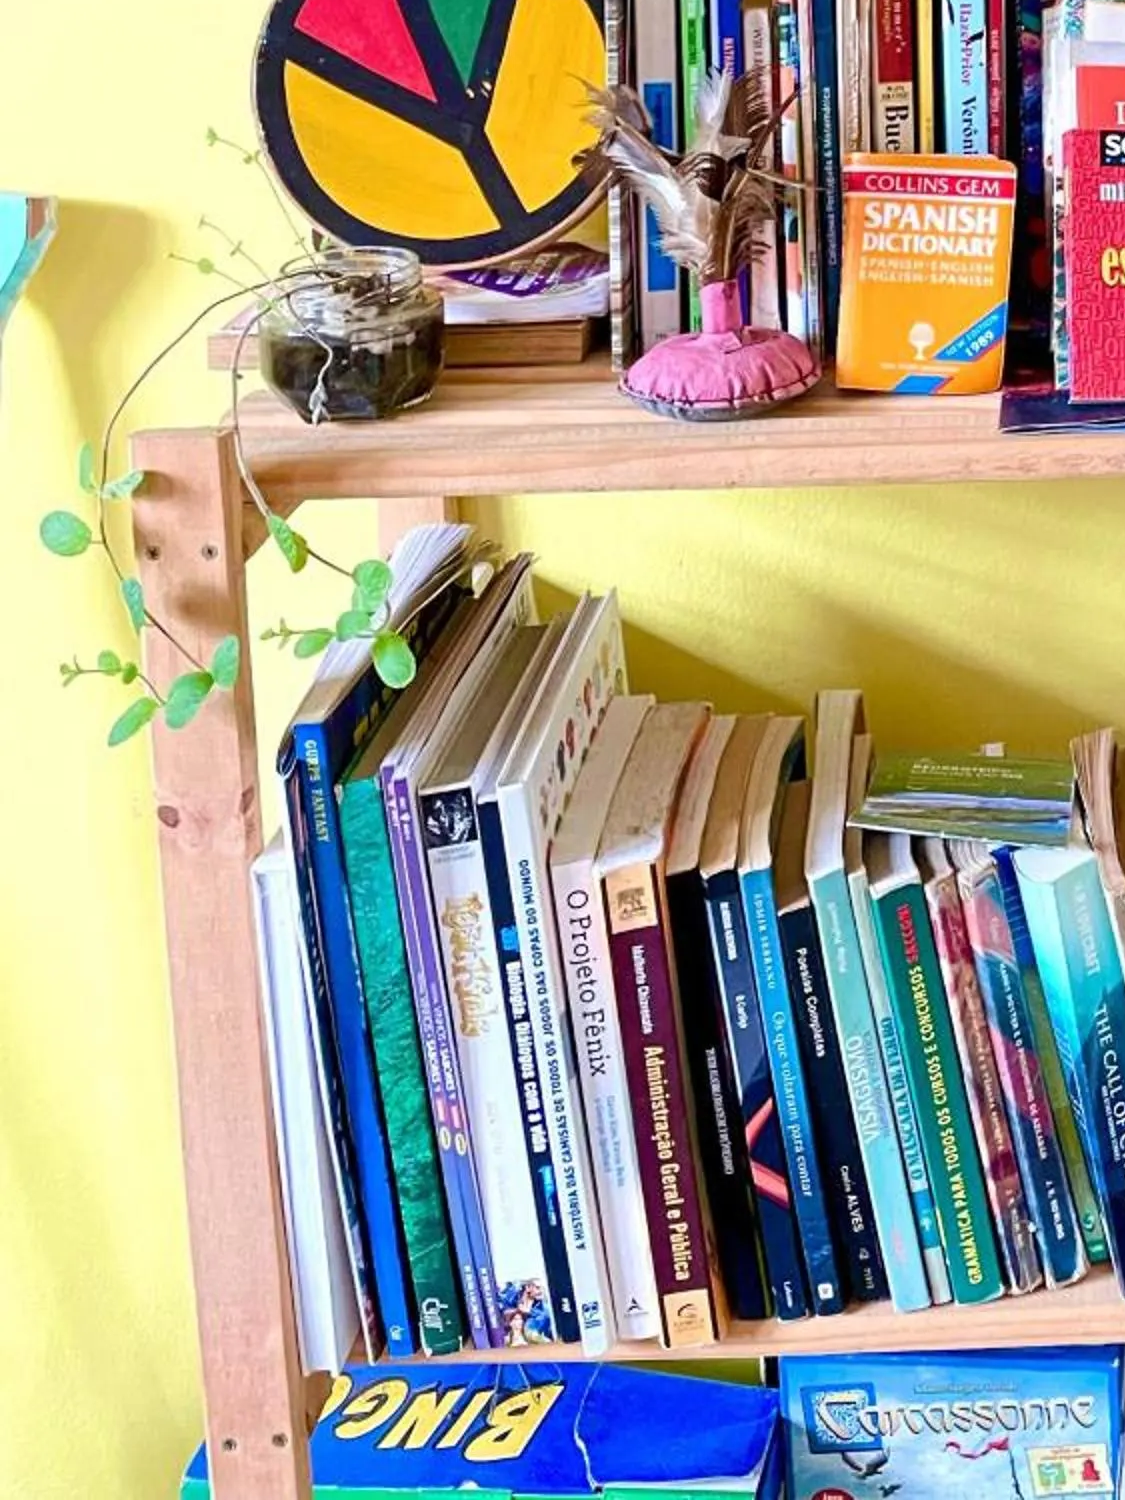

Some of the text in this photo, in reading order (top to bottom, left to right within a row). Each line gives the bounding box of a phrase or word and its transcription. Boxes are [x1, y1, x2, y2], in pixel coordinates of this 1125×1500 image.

[960, 46, 974, 85] Prior
[865, 174, 1000, 197] COLLINS GEM
[864, 201, 999, 235] SPANISH
[862, 231, 997, 257] DICTIONARY
[965, 330, 994, 357] 1989
[310, 787, 331, 843] FANTASY
[519, 857, 536, 903] MUNDO
[526, 906, 539, 924] DO
[529, 927, 545, 967] COPAS
[535, 969, 549, 994] DAS
[564, 888, 611, 1077] O Projeto Fênix
[539, 996, 555, 1036] JOGOS
[794, 946, 827, 1058] Poesias Completas
[913, 964, 936, 1042] CONCURSOS
[771, 1032, 788, 1059] que
[1092, 1005, 1114, 1046] THE
[545, 1039, 558, 1056] OS
[924, 1043, 938, 1053] E
[548, 1058, 564, 1093] TODOS
[779, 1060, 802, 1121] voltaram
[844, 1034, 881, 1144] VISAGISMO
[890, 1068, 906, 1091] DE
[929, 1055, 948, 1105] CURSOS
[1100, 1048, 1125, 1097] CALL
[936, 1107, 952, 1125] OS
[556, 1114, 573, 1163] CAMISAS
[788, 1123, 805, 1153] para
[943, 1126, 960, 1170] TODOS
[563, 1164, 578, 1188] DAS
[639, 1044, 695, 1281] Administração Geral e Pública
[796, 1154, 814, 1197] contar
[951, 1172, 968, 1207] PARA
[566, 1189, 586, 1241] HISTÓRIA
[845, 1193, 864, 1232] ALVES
[576, 1242, 586, 1250] A
[957, 1208, 982, 1284] GRAMÁTICA
[818, 1394, 1099, 1440] Carcassonne
